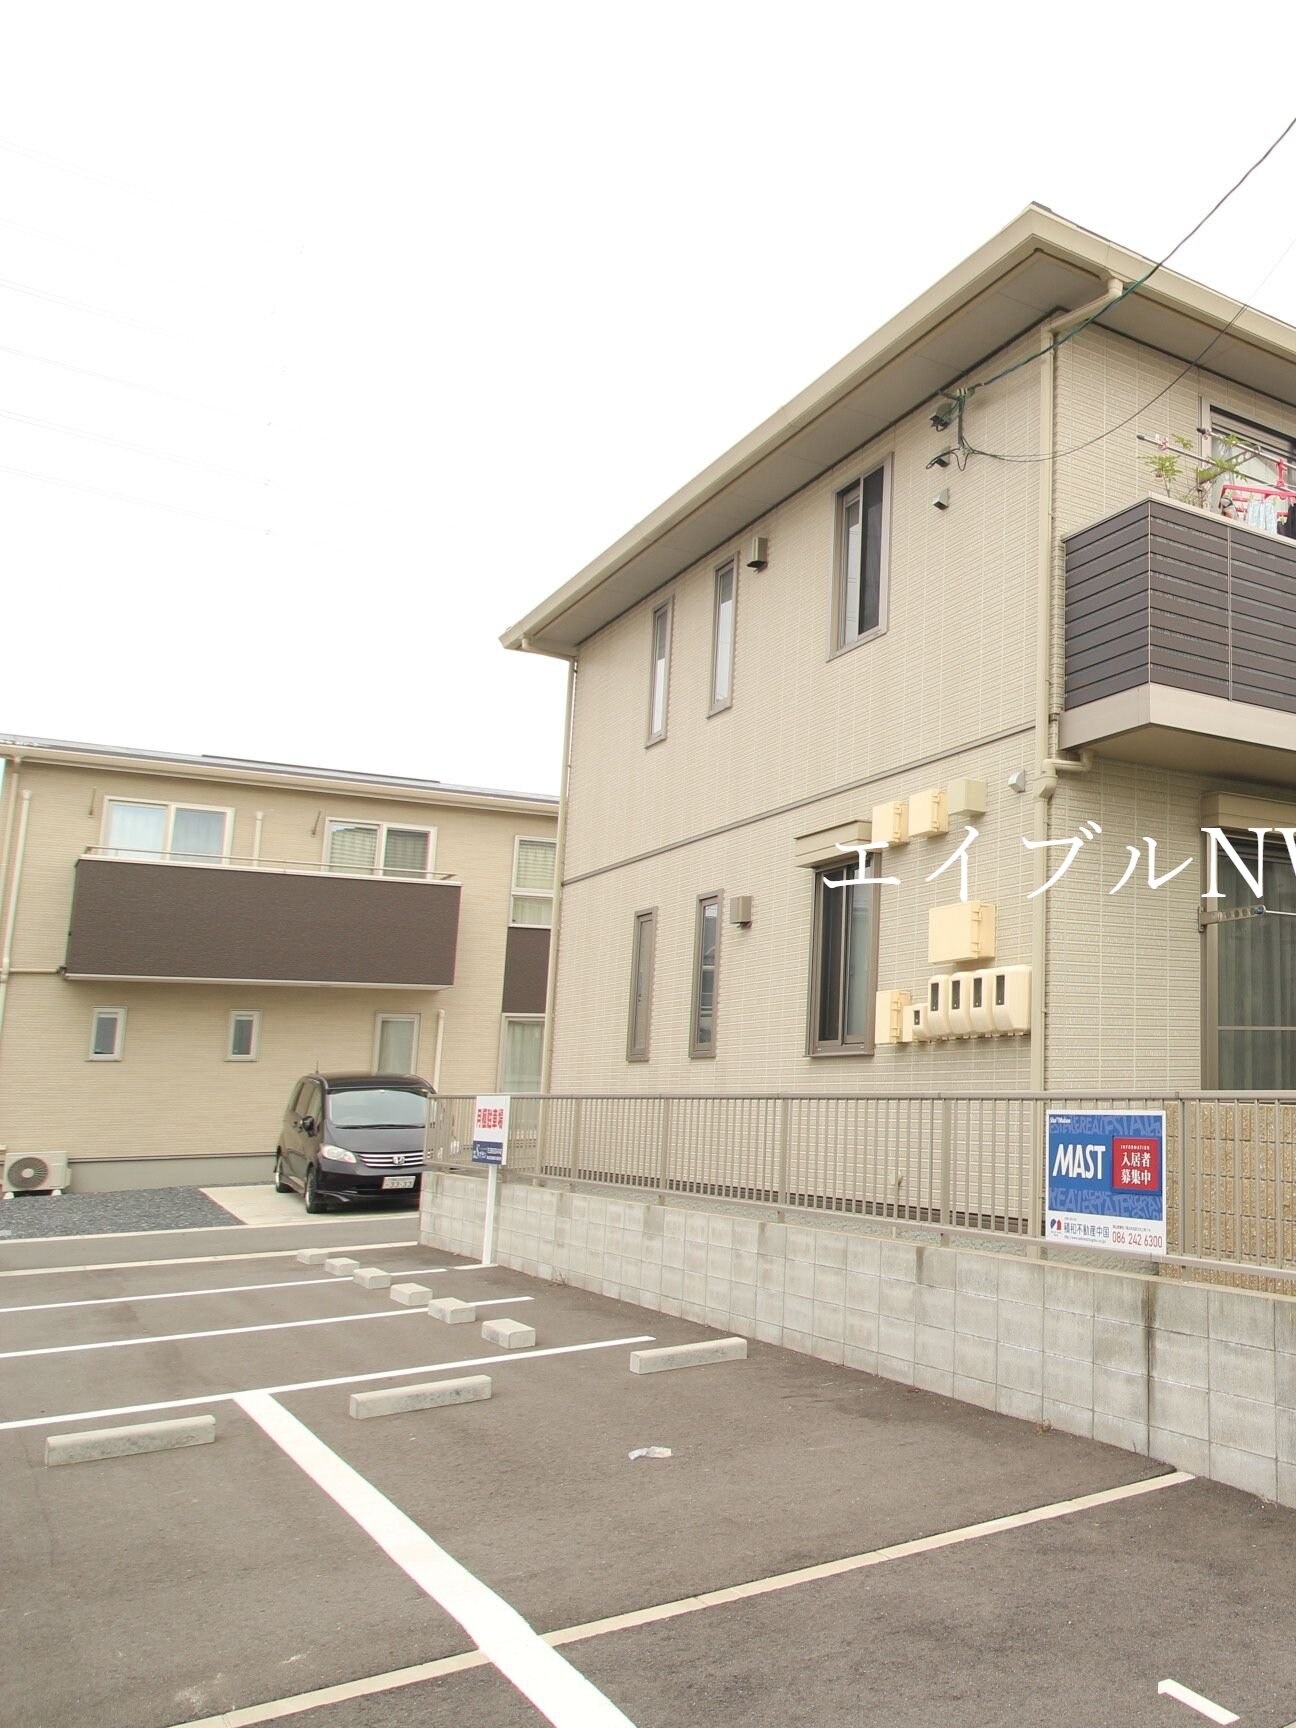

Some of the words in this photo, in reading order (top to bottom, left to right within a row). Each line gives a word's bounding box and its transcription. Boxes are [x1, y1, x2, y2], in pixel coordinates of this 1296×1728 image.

[1053, 1144, 1106, 1179] MAST
[1121, 1152, 1151, 1167] 入居者
[1121, 1169, 1151, 1185] 募集中
[1112, 1231, 1126, 1244] 086
[1128, 1233, 1142, 1246] 242
[1143, 1235, 1162, 1248] 6300
